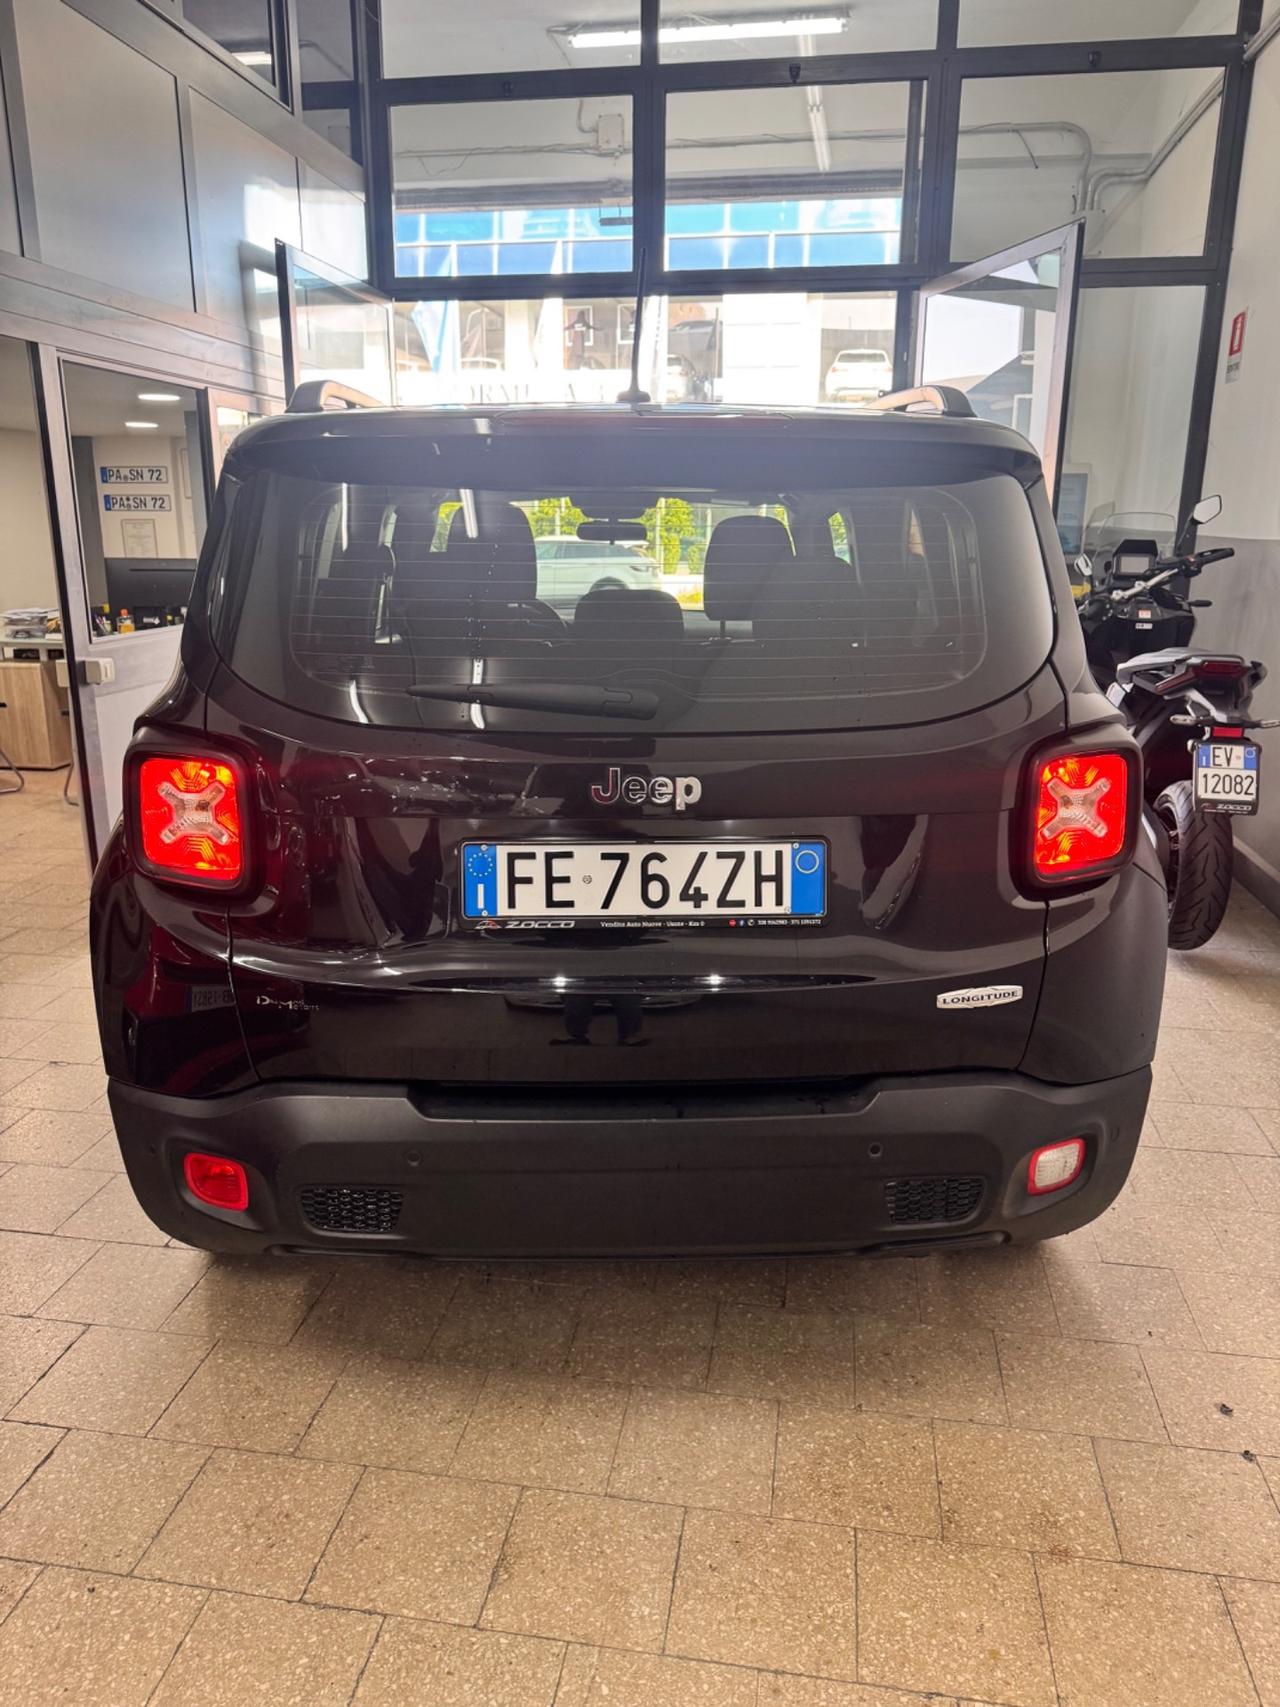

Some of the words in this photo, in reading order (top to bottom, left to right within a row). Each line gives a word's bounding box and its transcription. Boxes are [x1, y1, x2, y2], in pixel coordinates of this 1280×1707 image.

[108, 469, 122, 481] PA
[129, 469, 144, 481] SN
[148, 469, 162, 481] 72
[112, 497, 126, 509] PA
[132, 497, 147, 509] SN
[151, 497, 166, 509] 72
[1212, 746, 1233, 767] EV
[591, 767, 702, 810] Jeep
[1202, 773, 1254, 795] 12082
[507, 851, 575, 909] FE
[600, 850, 783, 909] 764ZH
[505, 920, 576, 929] ZOCCO
[942, 990, 1018, 1004] LONGITUDE
